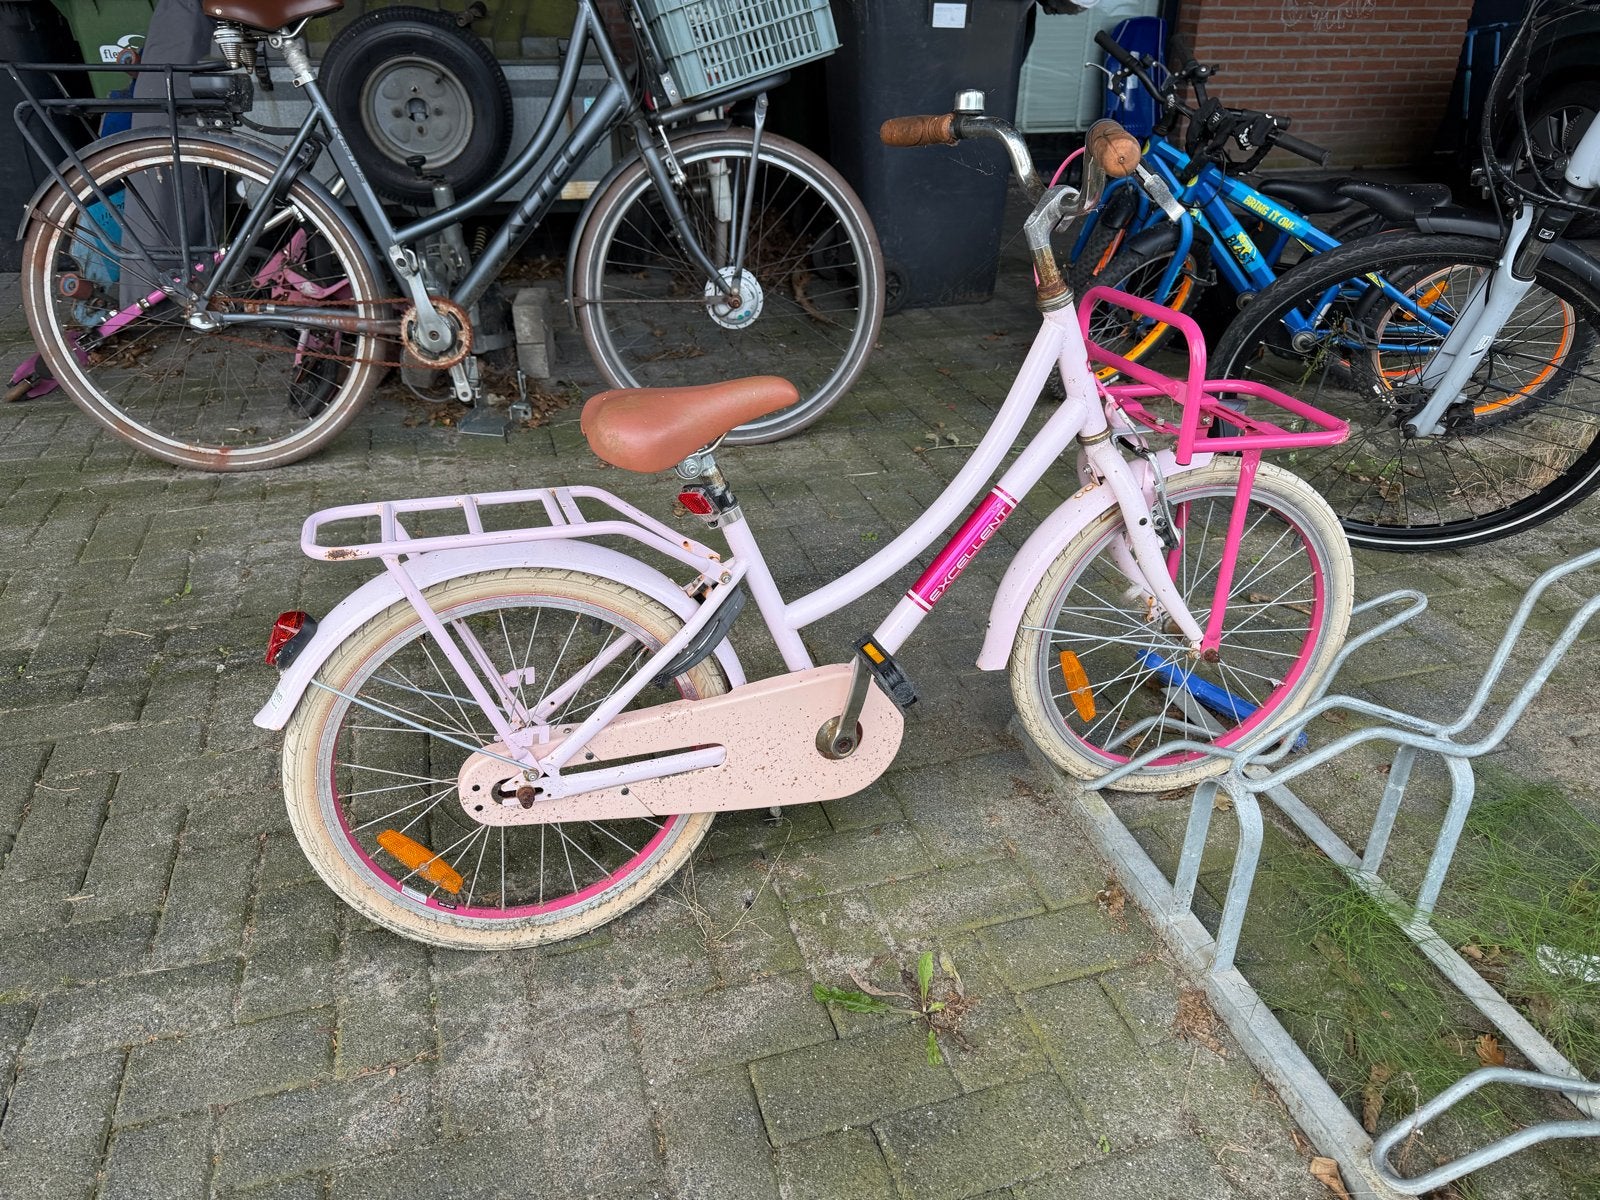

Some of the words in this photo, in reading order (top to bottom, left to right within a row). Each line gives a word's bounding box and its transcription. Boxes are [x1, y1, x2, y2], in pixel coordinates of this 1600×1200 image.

[103, 49, 119, 59] fle
[508, 134, 584, 243] ALTEC
[1243, 195, 1270, 216] BRING
[1267, 209, 1282, 222] IT
[1226, 233, 1255, 265] BLAST
[929, 506, 1007, 602] EXCELLENT
